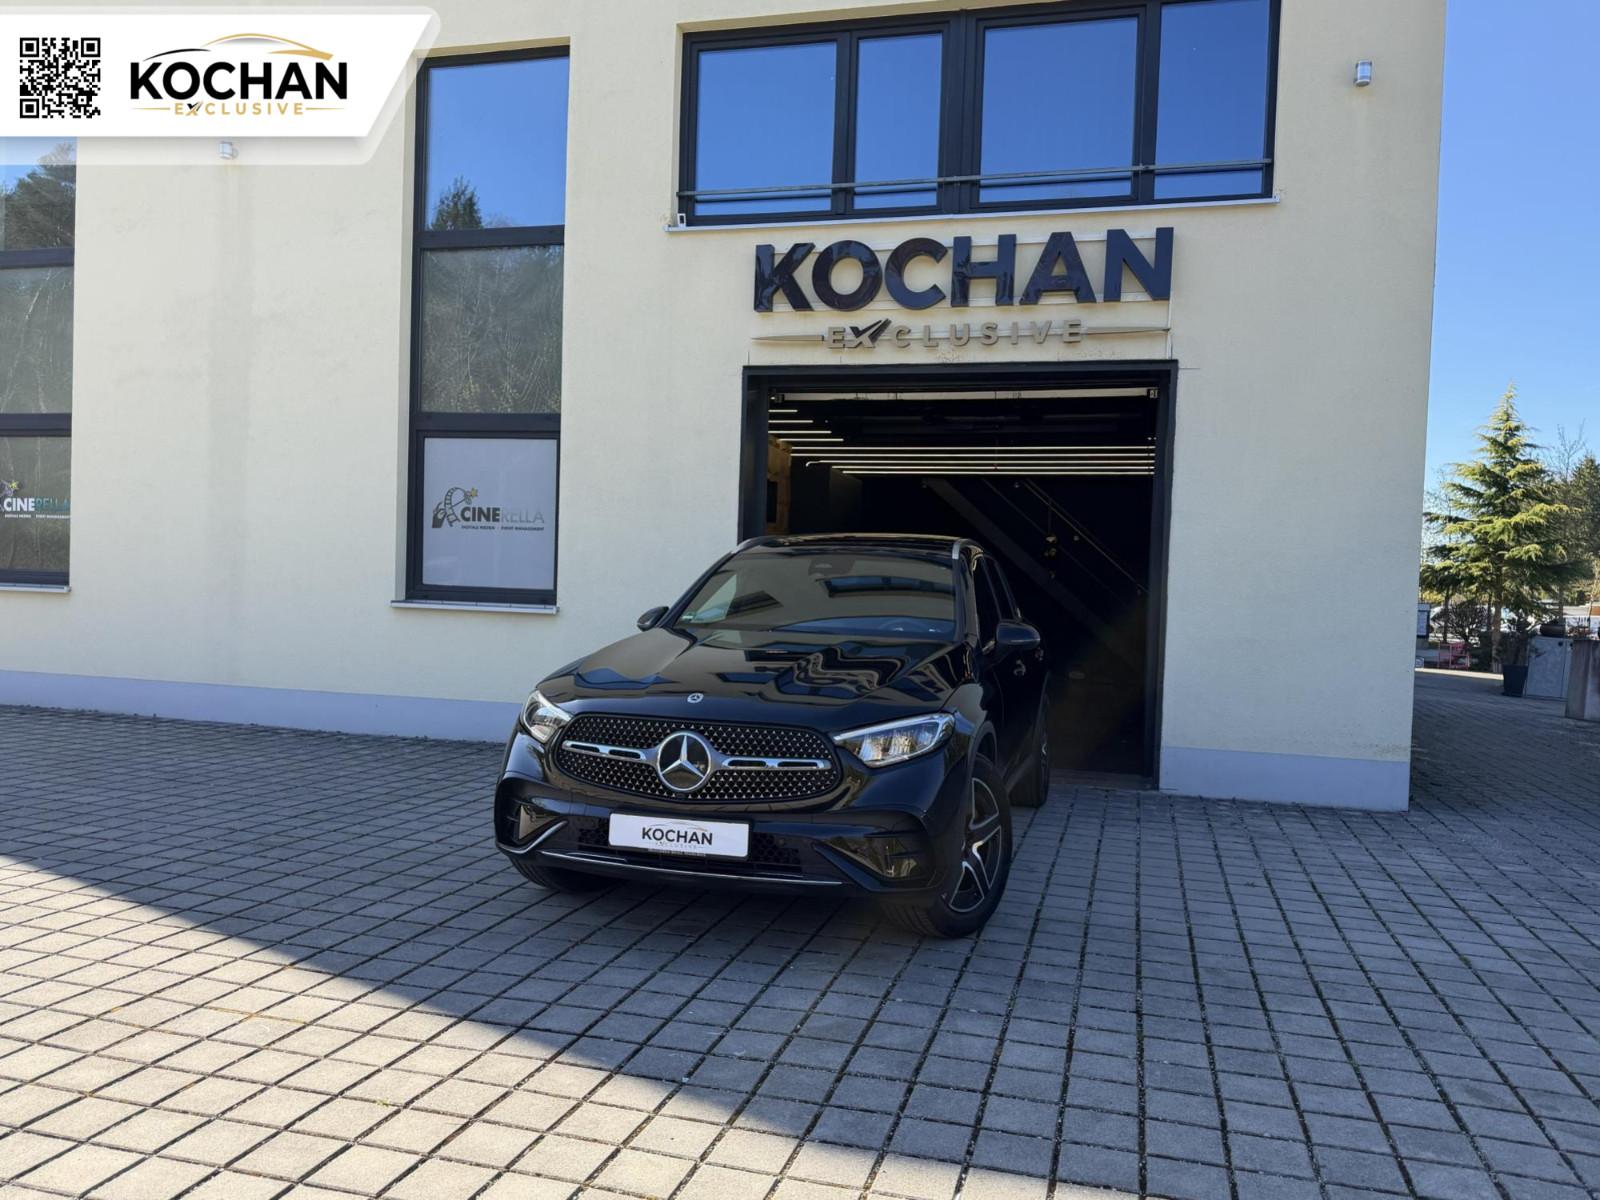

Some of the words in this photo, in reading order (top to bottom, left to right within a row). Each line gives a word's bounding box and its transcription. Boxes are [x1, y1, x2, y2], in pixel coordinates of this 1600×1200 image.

[753, 227, 1175, 313] KOCHAN
[826, 318, 1084, 349] EXCLUSIVE
[3, 497, 70, 512] CINERELLA
[460, 506, 544, 523] CINERELLA
[642, 827, 713, 845] KOCHAN
